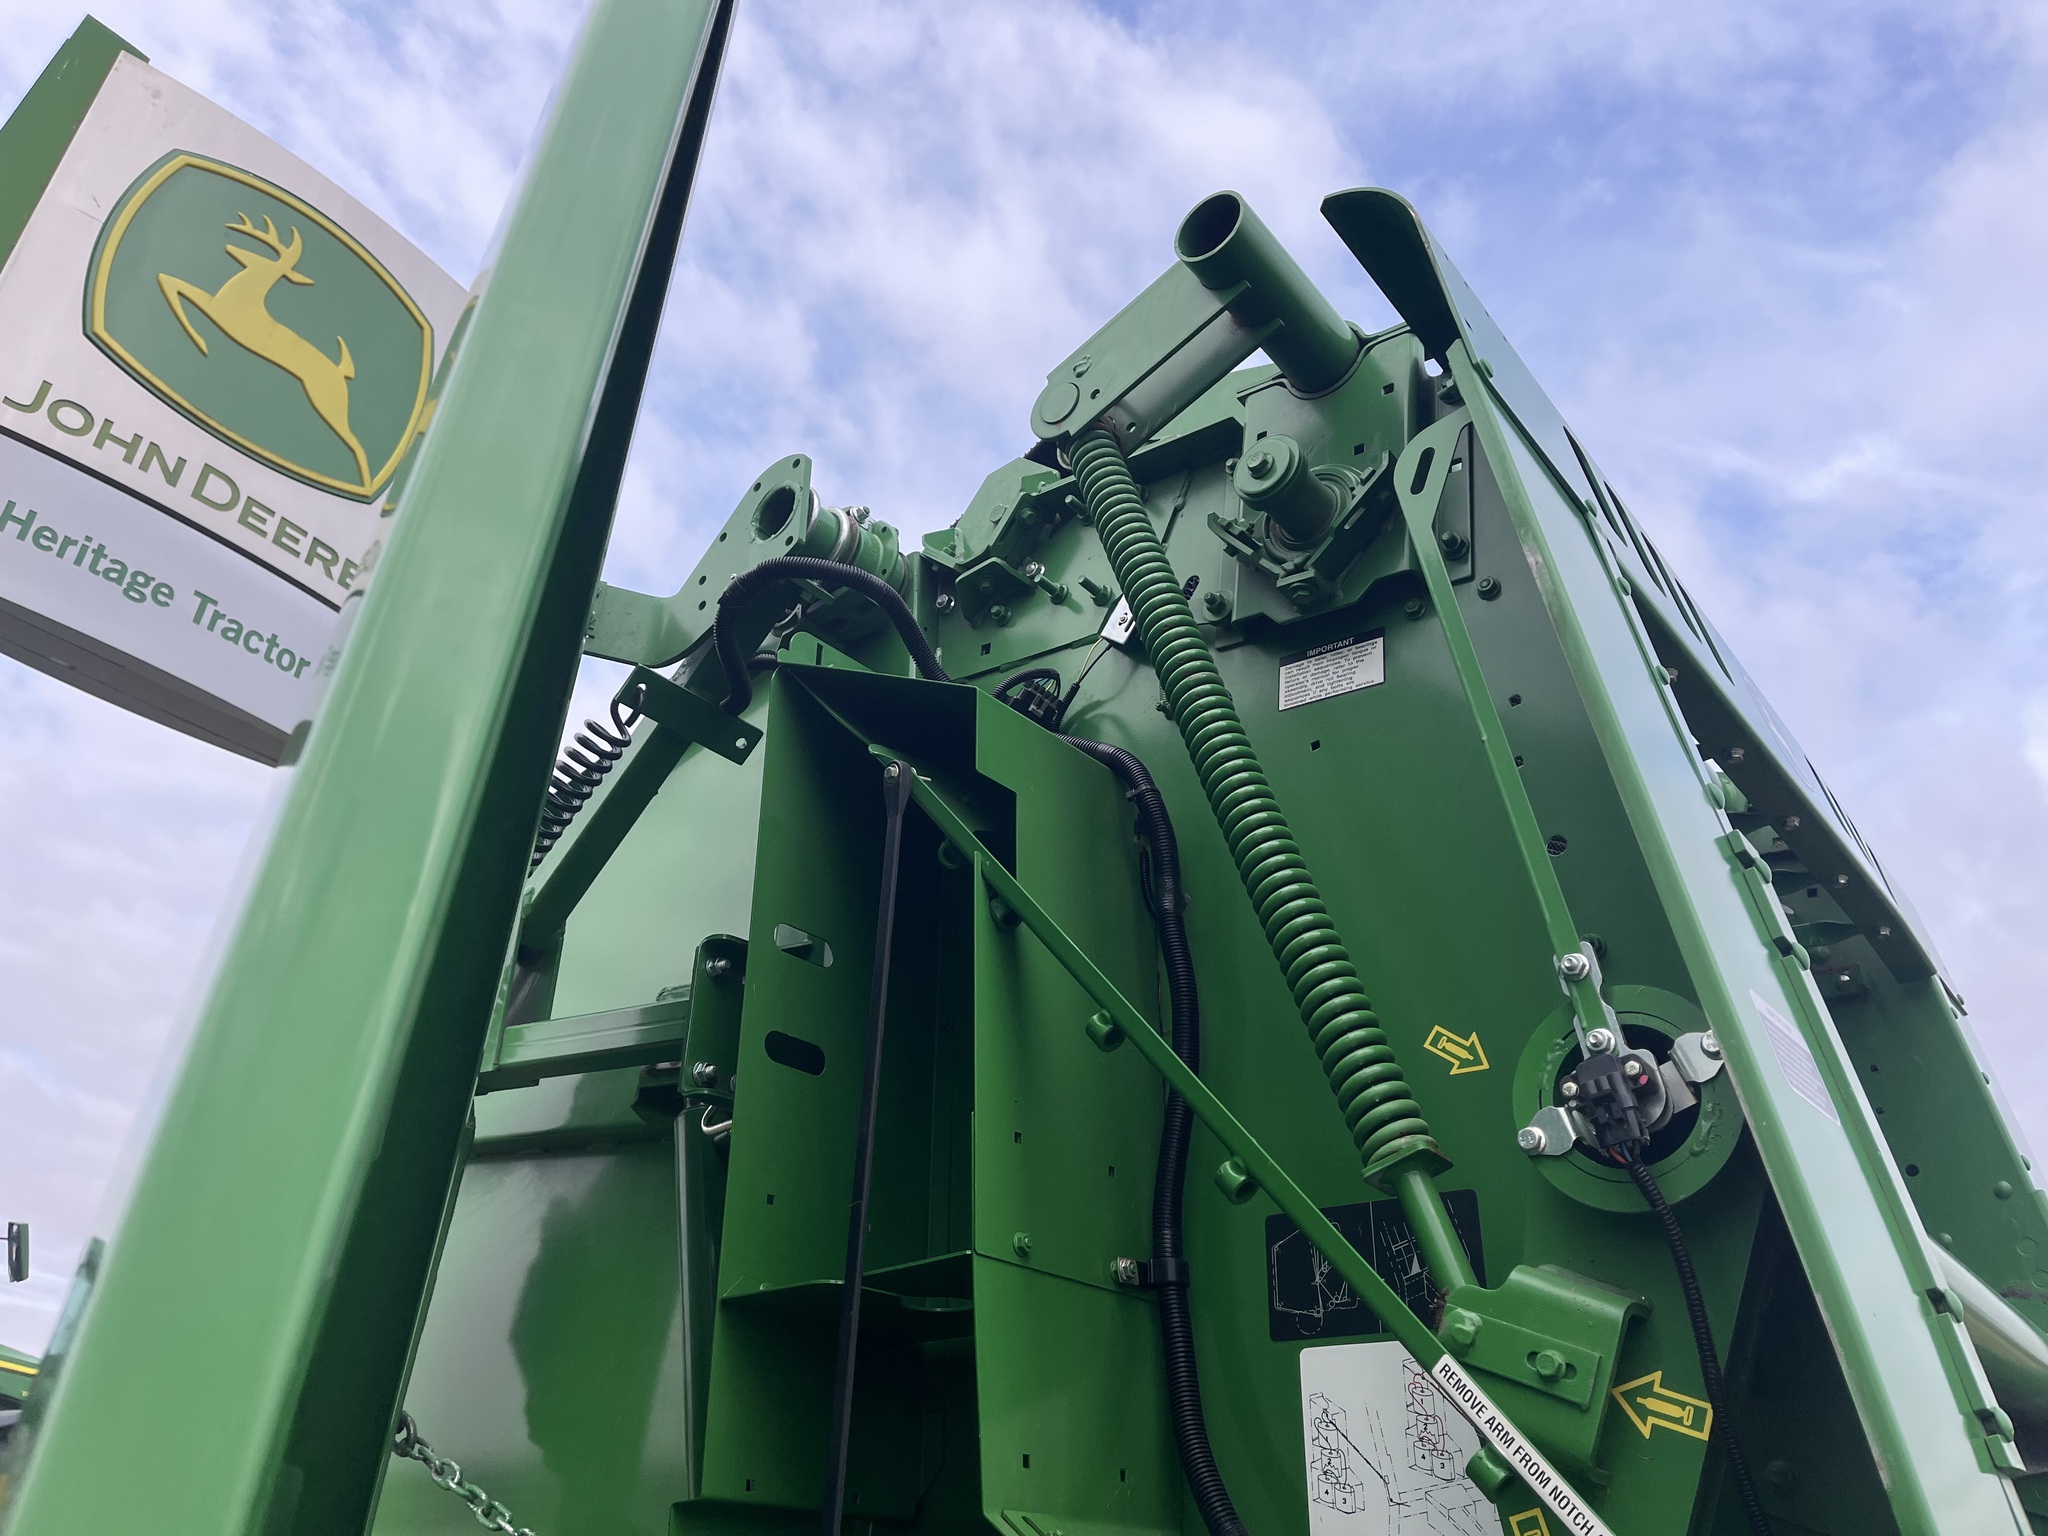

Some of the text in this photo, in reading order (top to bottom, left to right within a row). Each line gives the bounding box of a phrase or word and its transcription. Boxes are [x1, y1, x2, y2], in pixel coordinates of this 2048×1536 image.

[3, 380, 359, 591] JOHN DEERE
[0, 500, 311, 679] Heritage Tractor
[1306, 637, 1354, 657] IMPORTANT
[1439, 1363, 1595, 1536] REMOVE ARM FROM NOTCH
